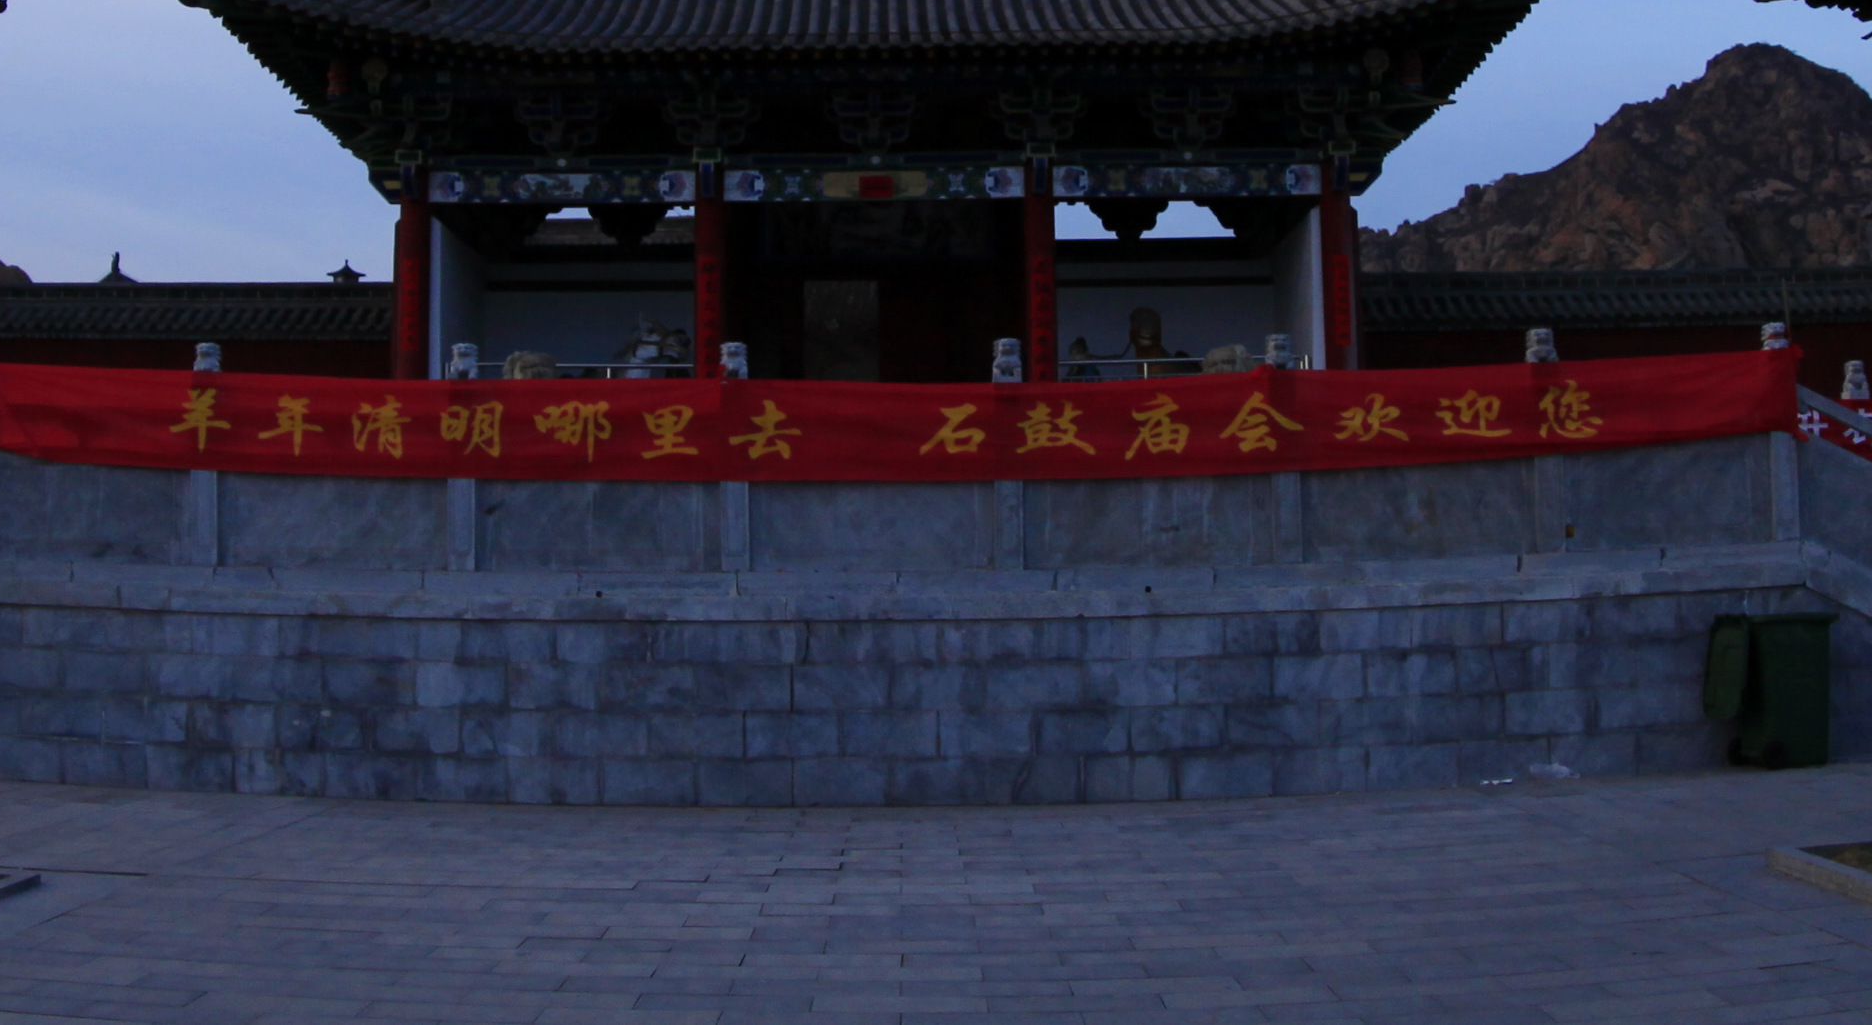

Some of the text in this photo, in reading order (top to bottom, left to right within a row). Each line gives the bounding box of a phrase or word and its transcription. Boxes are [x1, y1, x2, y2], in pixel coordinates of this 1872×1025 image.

[168, 378, 1604, 463] 羊年清明哪里去 石鼓庙会欢迎您
